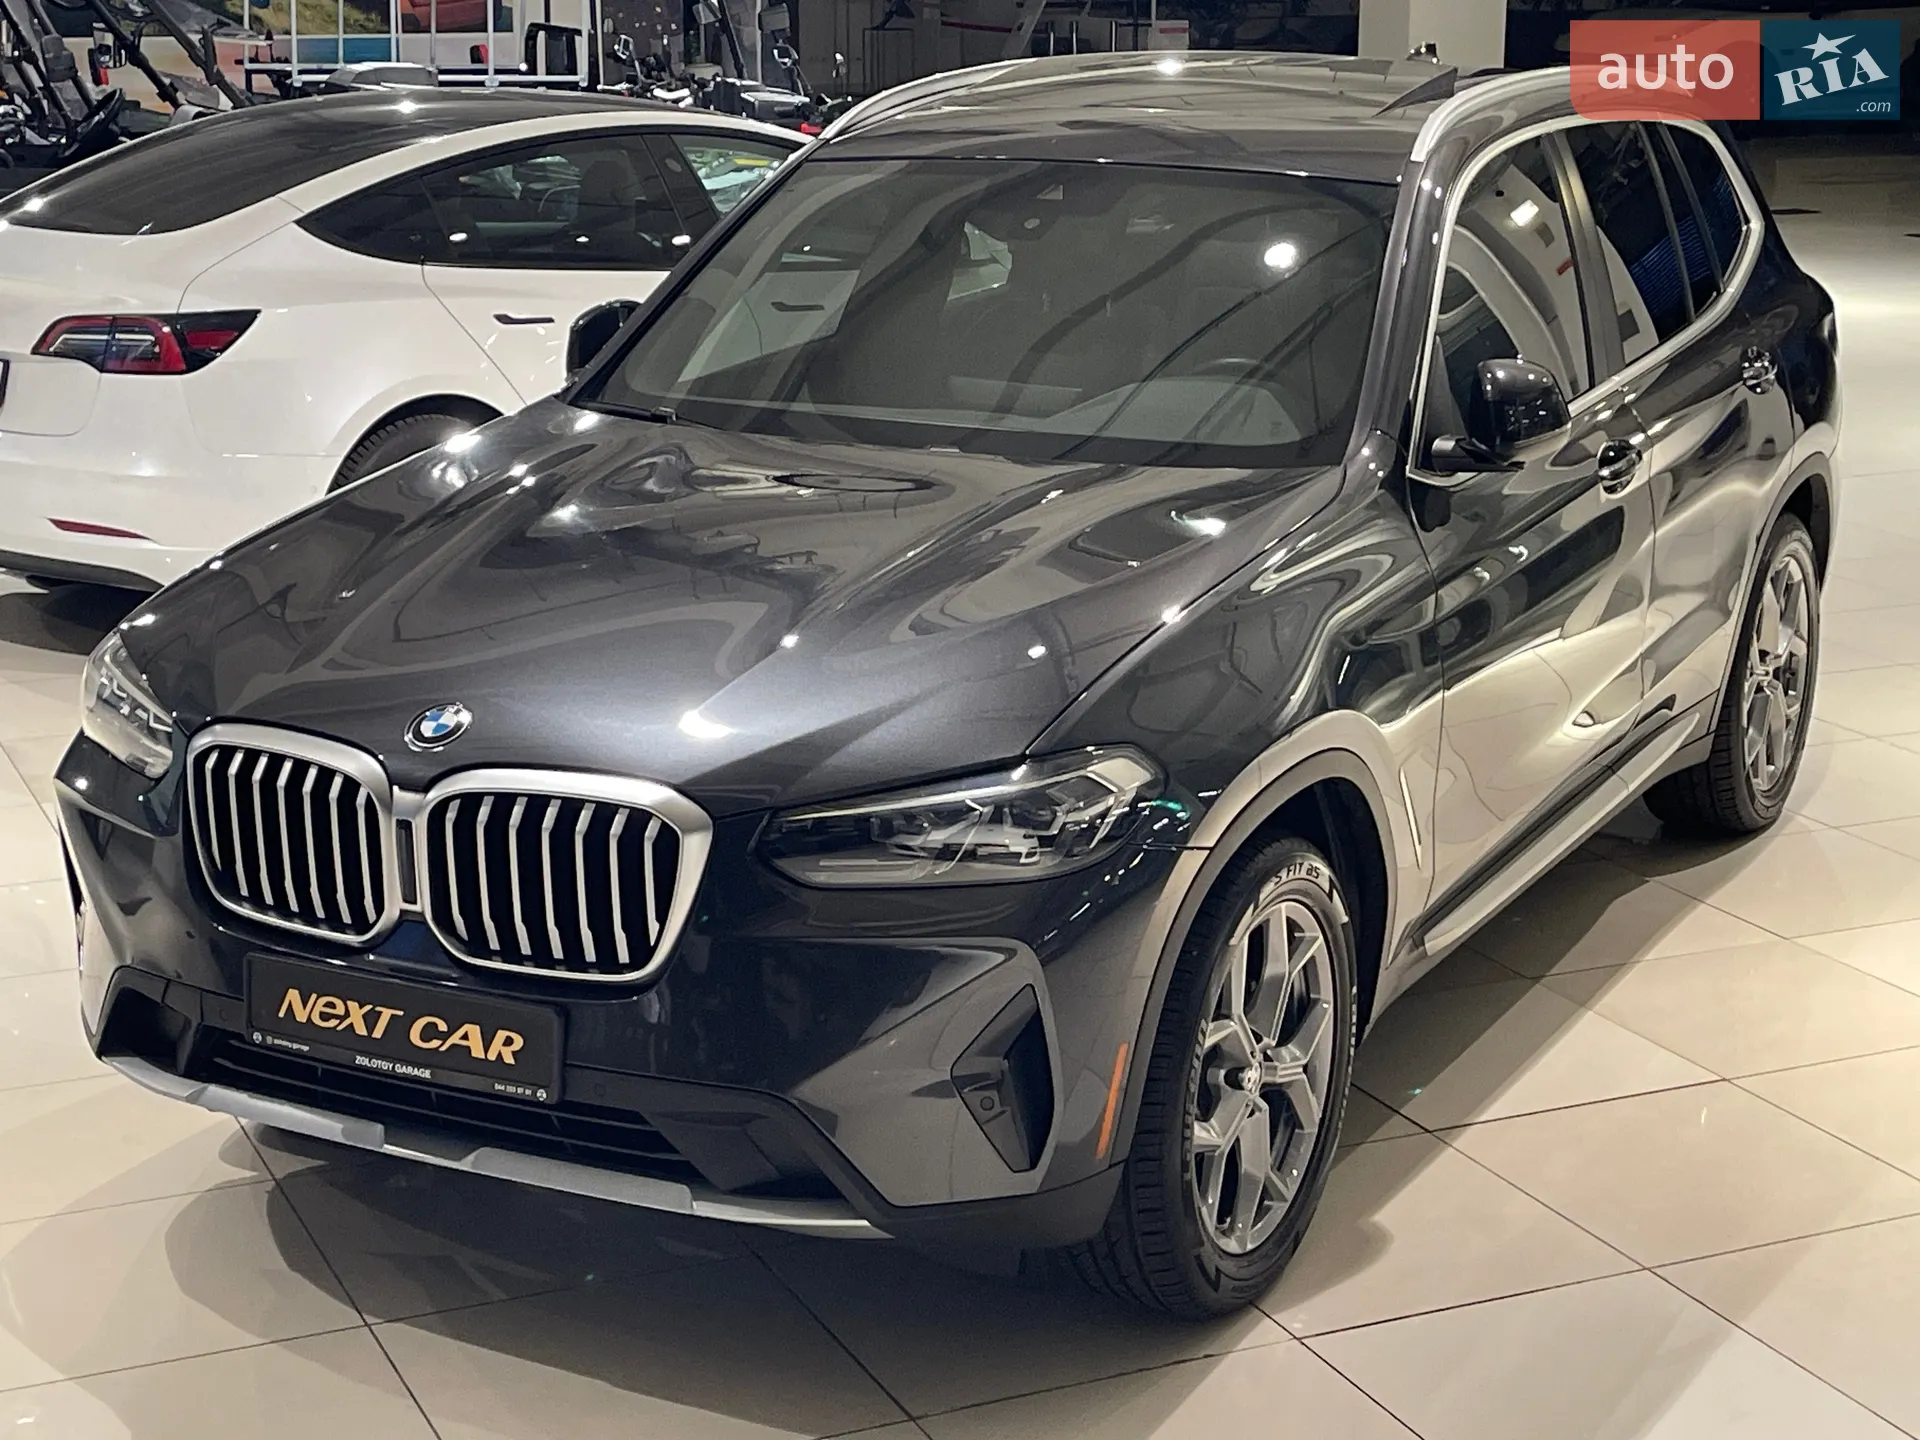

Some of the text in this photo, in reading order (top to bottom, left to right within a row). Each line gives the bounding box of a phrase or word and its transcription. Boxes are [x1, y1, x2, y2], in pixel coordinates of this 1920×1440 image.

[1286, 861, 1304, 879] FIT
[409, 1015, 524, 1065] CAR
[394, 1063, 432, 1079] GARAGE
